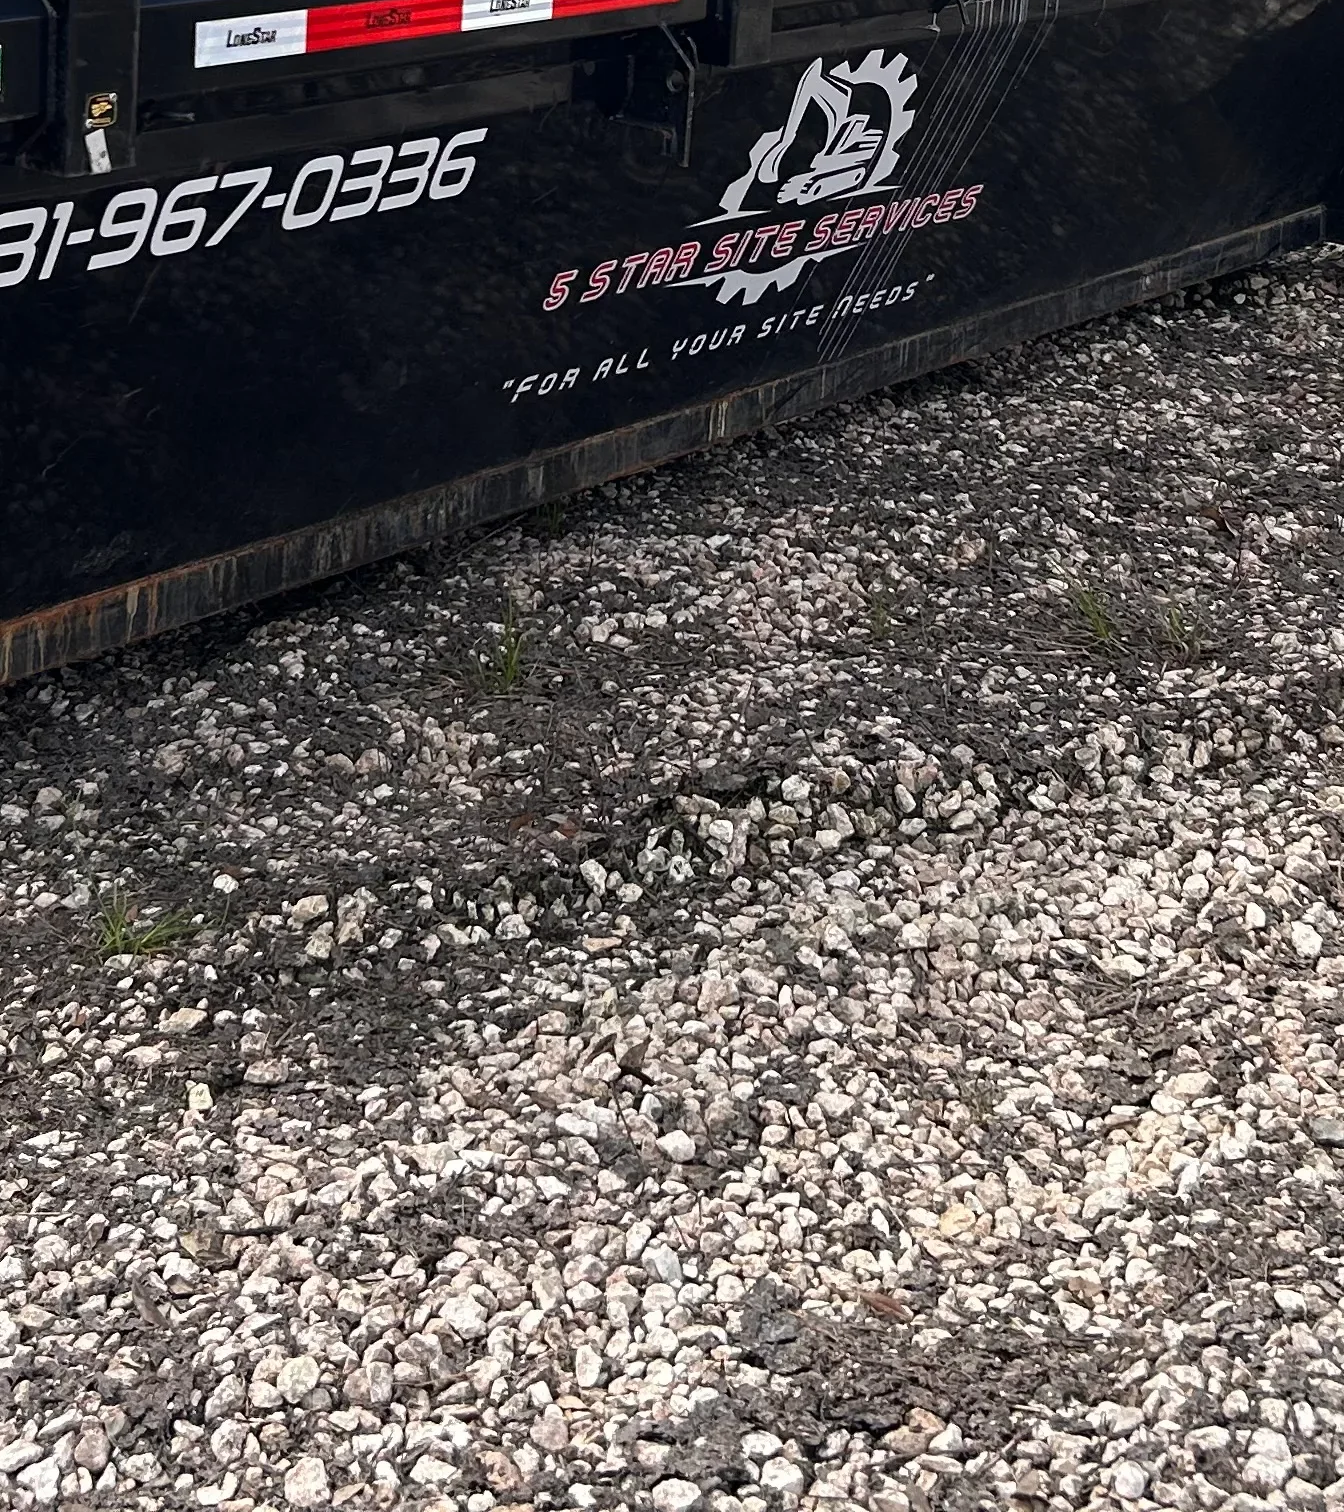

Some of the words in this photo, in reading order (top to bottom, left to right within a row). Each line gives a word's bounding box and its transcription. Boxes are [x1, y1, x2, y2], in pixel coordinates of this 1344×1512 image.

[543, 269, 578, 312] 5
[580, 240, 702, 303] STAR
[704, 220, 806, 273] SITE
[804, 184, 984, 252] SERVICES
[502, 367, 578, 405] "FOR
[592, 346, 651, 381] ALL
[670, 322, 746, 361] YOUR
[756, 304, 824, 339] SITE
[832, 273, 936, 320] NEEDS"
